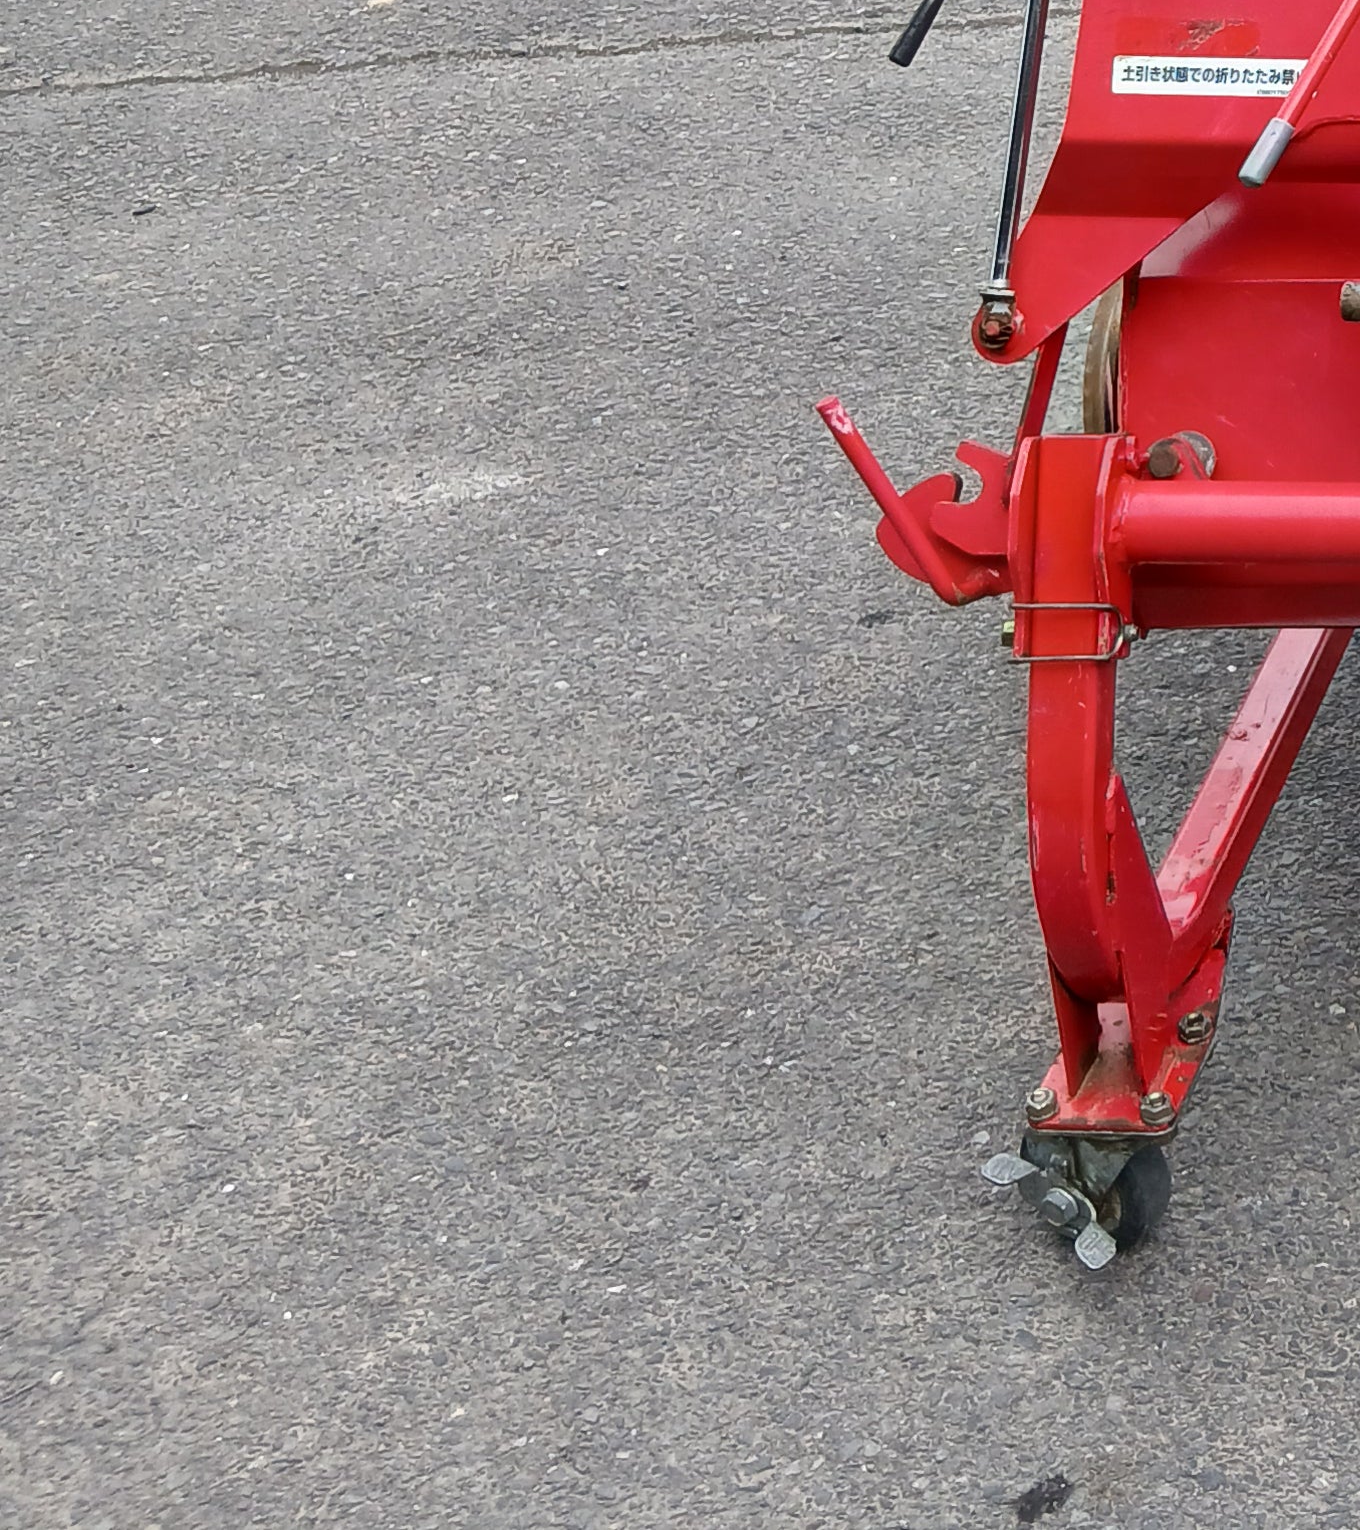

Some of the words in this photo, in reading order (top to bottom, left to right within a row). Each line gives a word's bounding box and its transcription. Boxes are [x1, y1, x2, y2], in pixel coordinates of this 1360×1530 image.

[1122, 66, 1300, 85] 土引き状態での折りたたみ禁
